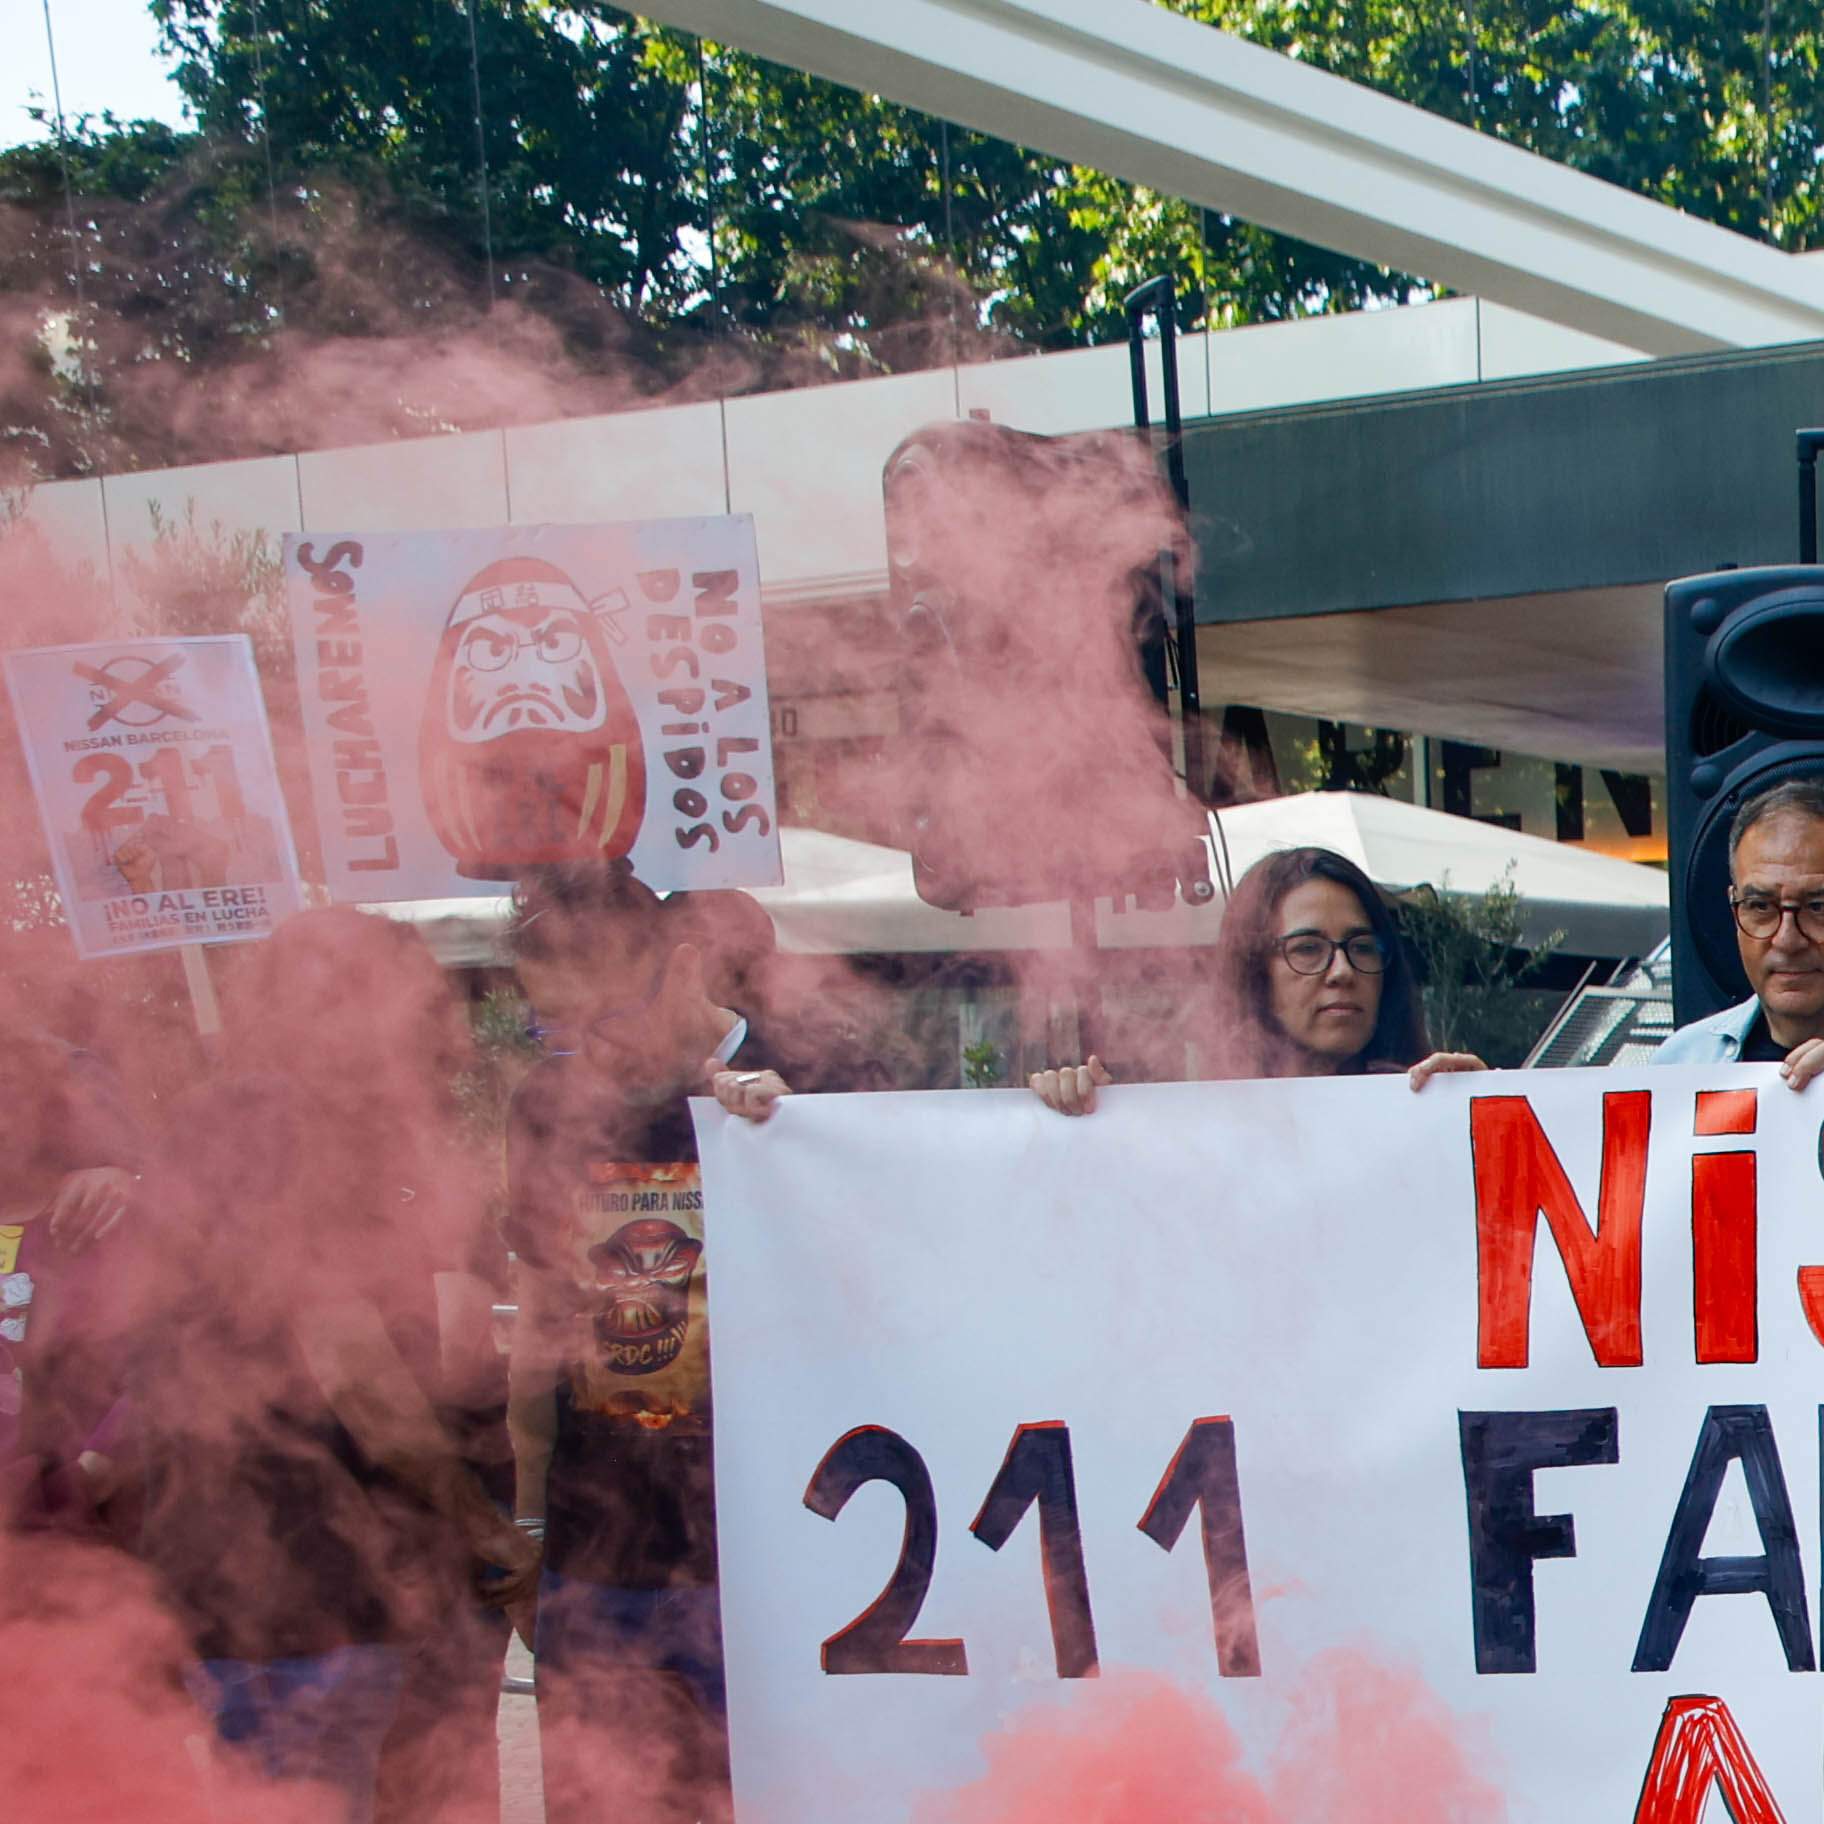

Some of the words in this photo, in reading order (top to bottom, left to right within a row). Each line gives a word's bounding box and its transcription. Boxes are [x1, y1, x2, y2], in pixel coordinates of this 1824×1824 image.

[692, 569, 739, 654] NO
[711, 678, 752, 711] A
[63, 733, 124, 752] NISSAN
[716, 737, 770, 837] LOS
[158, 893, 196, 912] AL
[203, 886, 267, 908] ERE!
[107, 913, 180, 932] FAMILIAS
[184, 911, 207, 924] EN
[211, 906, 270, 921] LUCHA
[631, 1191, 669, 1211] PARA
[672, 1190, 704, 1211] NISS
[801, 1413, 1264, 1679] 211
